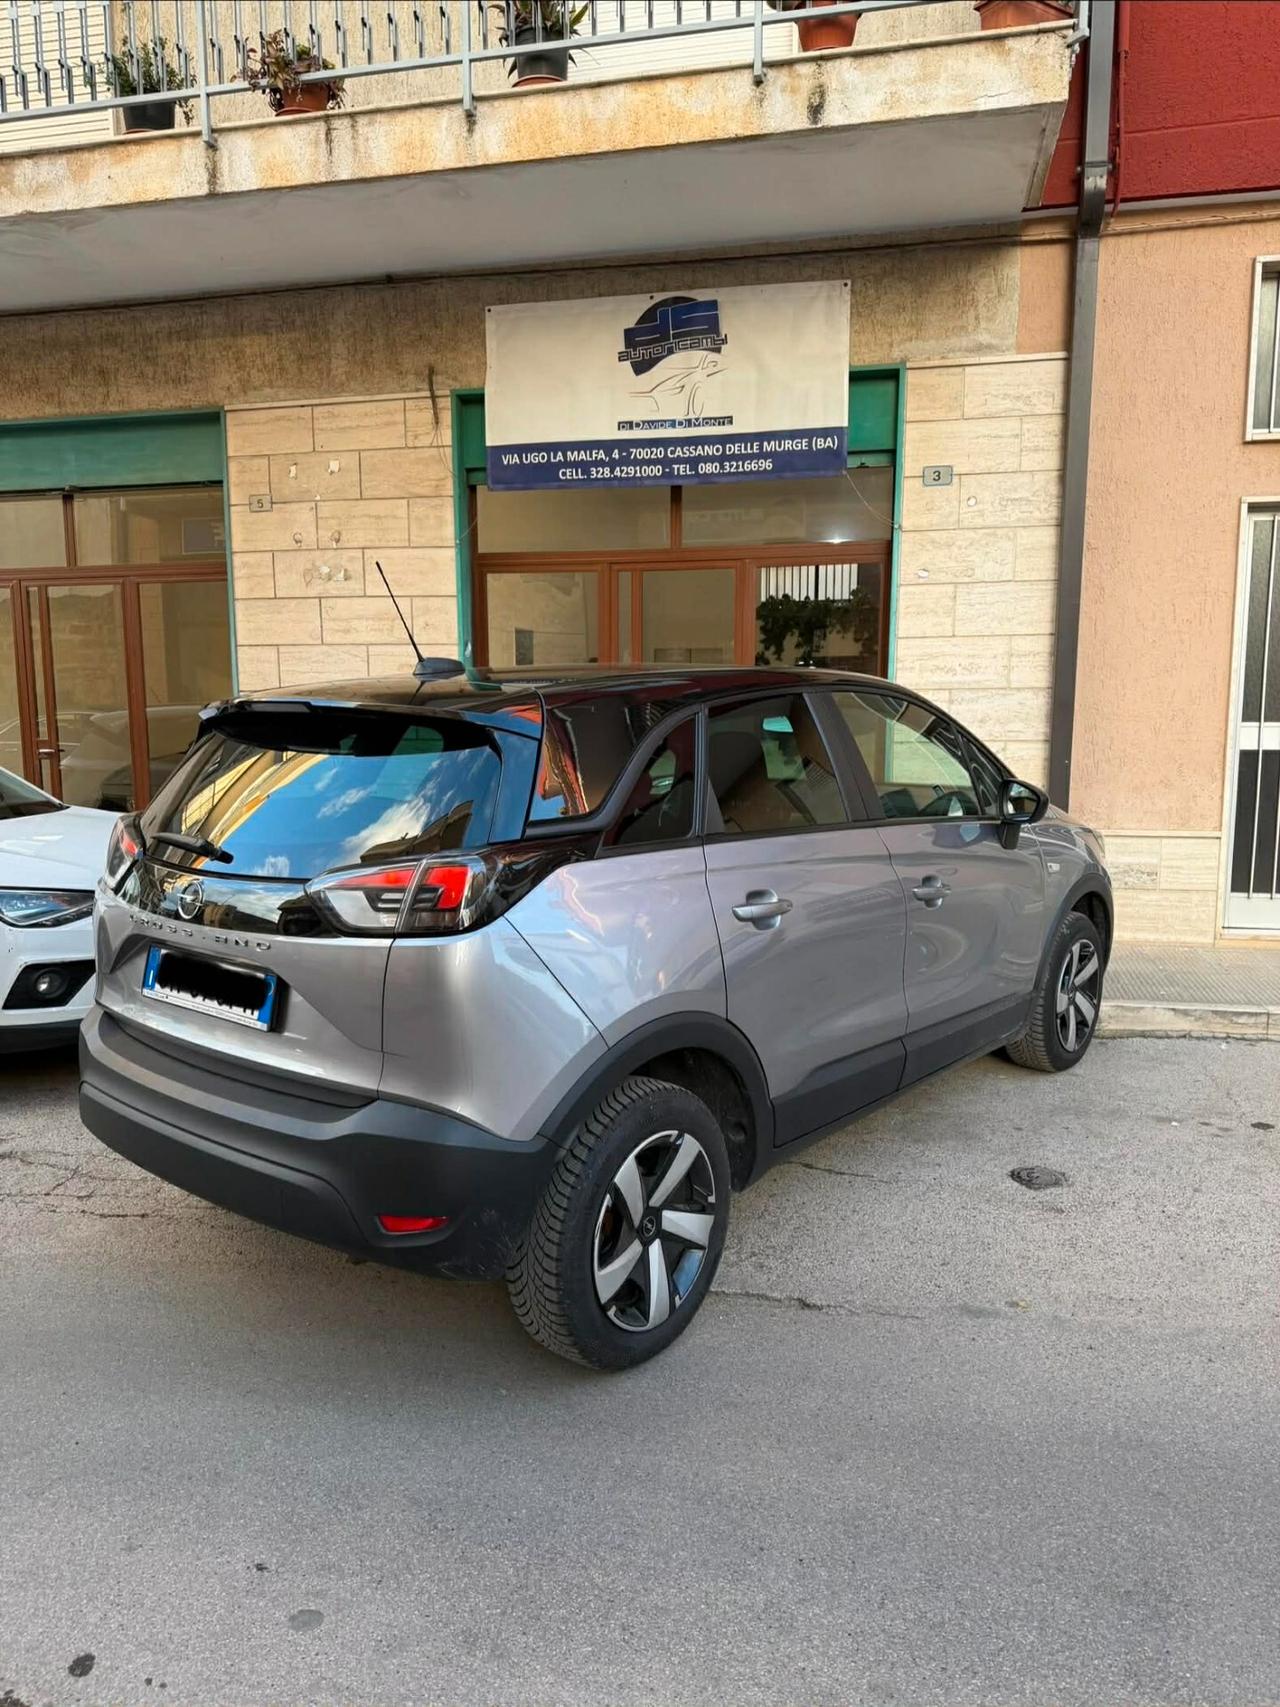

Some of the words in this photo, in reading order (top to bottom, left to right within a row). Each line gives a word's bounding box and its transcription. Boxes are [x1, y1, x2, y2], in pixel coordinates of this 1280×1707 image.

[502, 453, 520, 466] VIA
[522, 452, 547, 464] UGO
[550, 451, 564, 463] LA
[566, 449, 609, 463] MALFA,
[611, 448, 620, 460] 4
[629, 447, 665, 460] 70020
[667, 444, 723, 458] CASSANO
[725, 442, 760, 455] DELLE
[763, 439, 809, 452] MURGE
[812, 435, 839, 451] (BA)
[559, 468, 587, 480] CELL.
[590, 465, 663, 479] 328.4291000
[672, 463, 695, 476] TEL.
[698, 459, 773, 474] 080.3216696
[933, 471, 941, 481] 3
[257, 499, 264, 508] 5
[128, 913, 272, 952] CROSSAND
